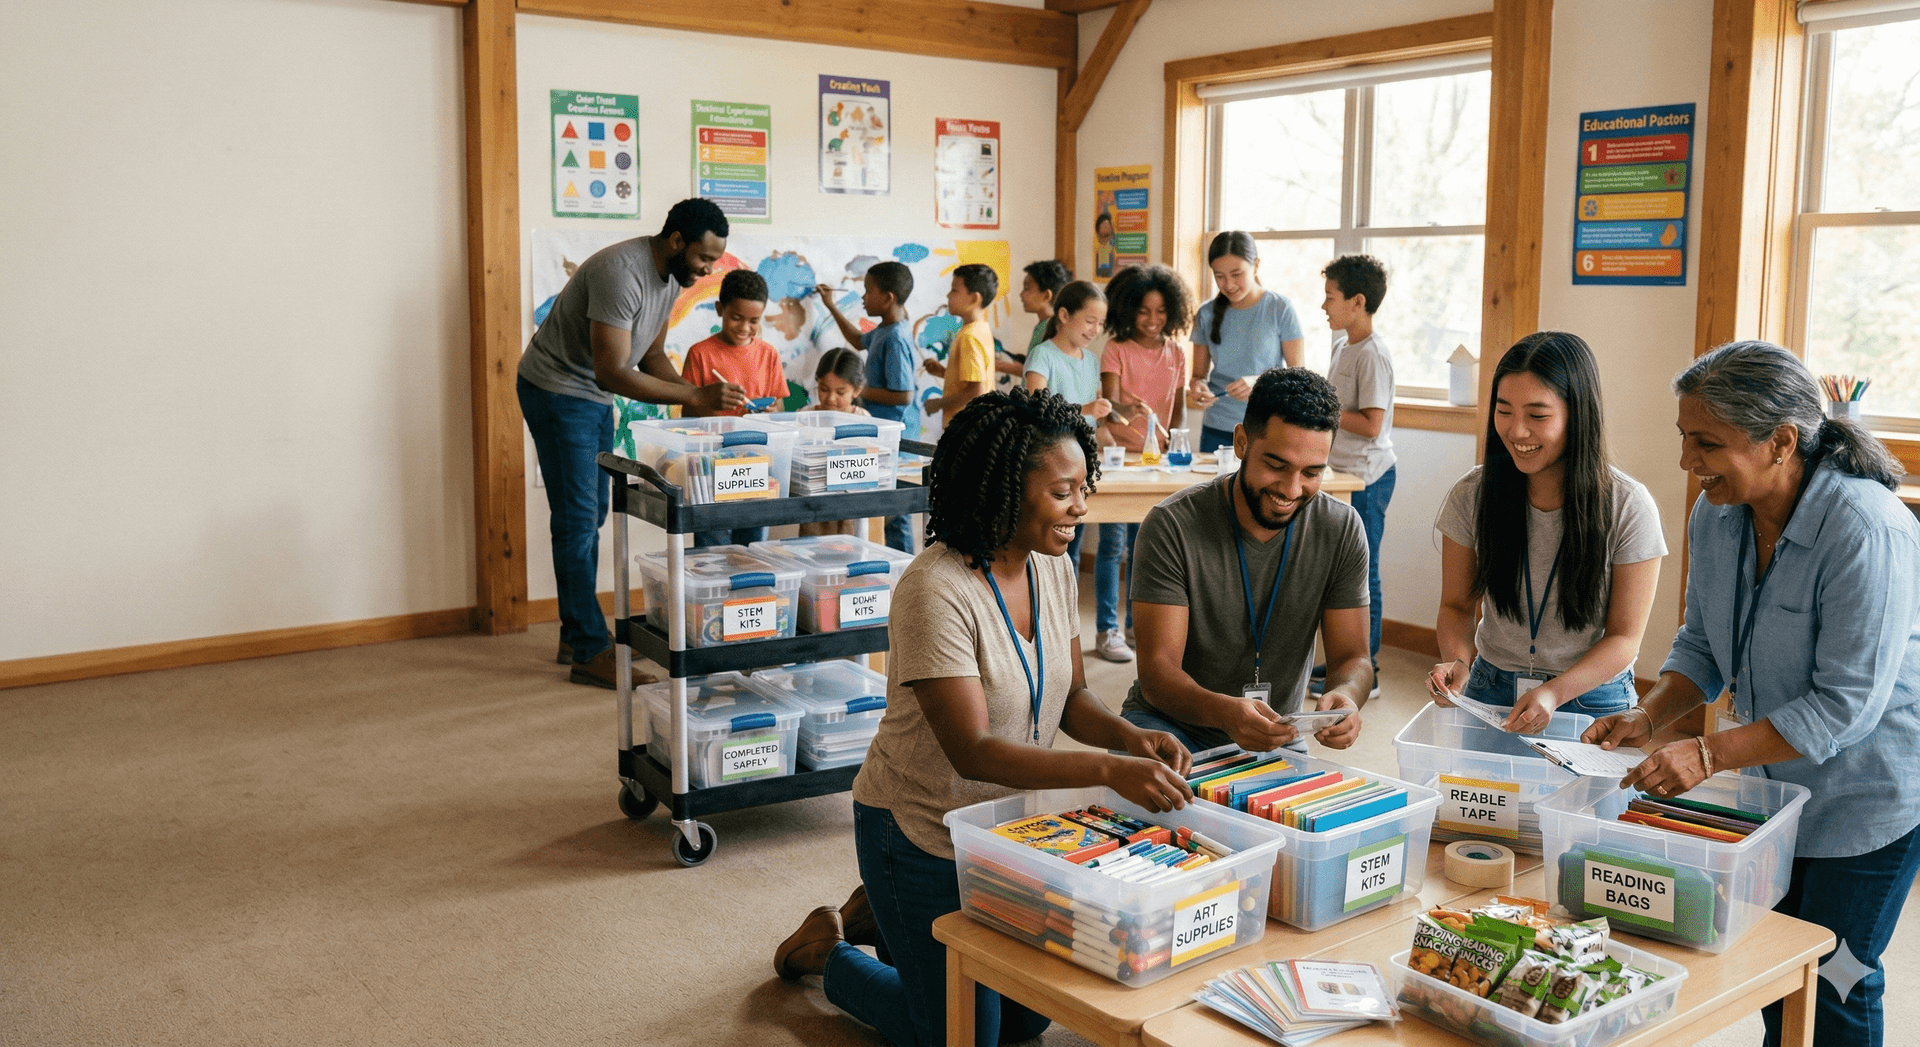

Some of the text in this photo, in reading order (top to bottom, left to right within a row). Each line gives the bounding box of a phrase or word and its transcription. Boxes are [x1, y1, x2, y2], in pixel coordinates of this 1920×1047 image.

[1583, 115, 1647, 131] Educational
[702, 130, 709, 142] 1
[1588, 144, 1598, 161] 1
[702, 164, 710, 176] 3
[702, 181, 711, 193] 4
[1582, 254, 1595, 272] 6
[731, 467, 752, 478] ART
[839, 470, 866, 480] CARD
[717, 478, 765, 491] SUPPLIES
[737, 607, 763, 618] STEM
[854, 606, 874, 616] KITS
[740, 619, 761, 629] KITS
[1450, 789, 1506, 807] REABLE
[1459, 806, 1497, 822] TAPE
[1360, 852, 1390, 874] STEM
[1361, 872, 1386, 891] KITS
[1592, 867, 1666, 895] READING
[1606, 889, 1650, 910] BAGS
[1193, 902, 1218, 923] ART
[1176, 915, 1234, 947] SUPPLIES
